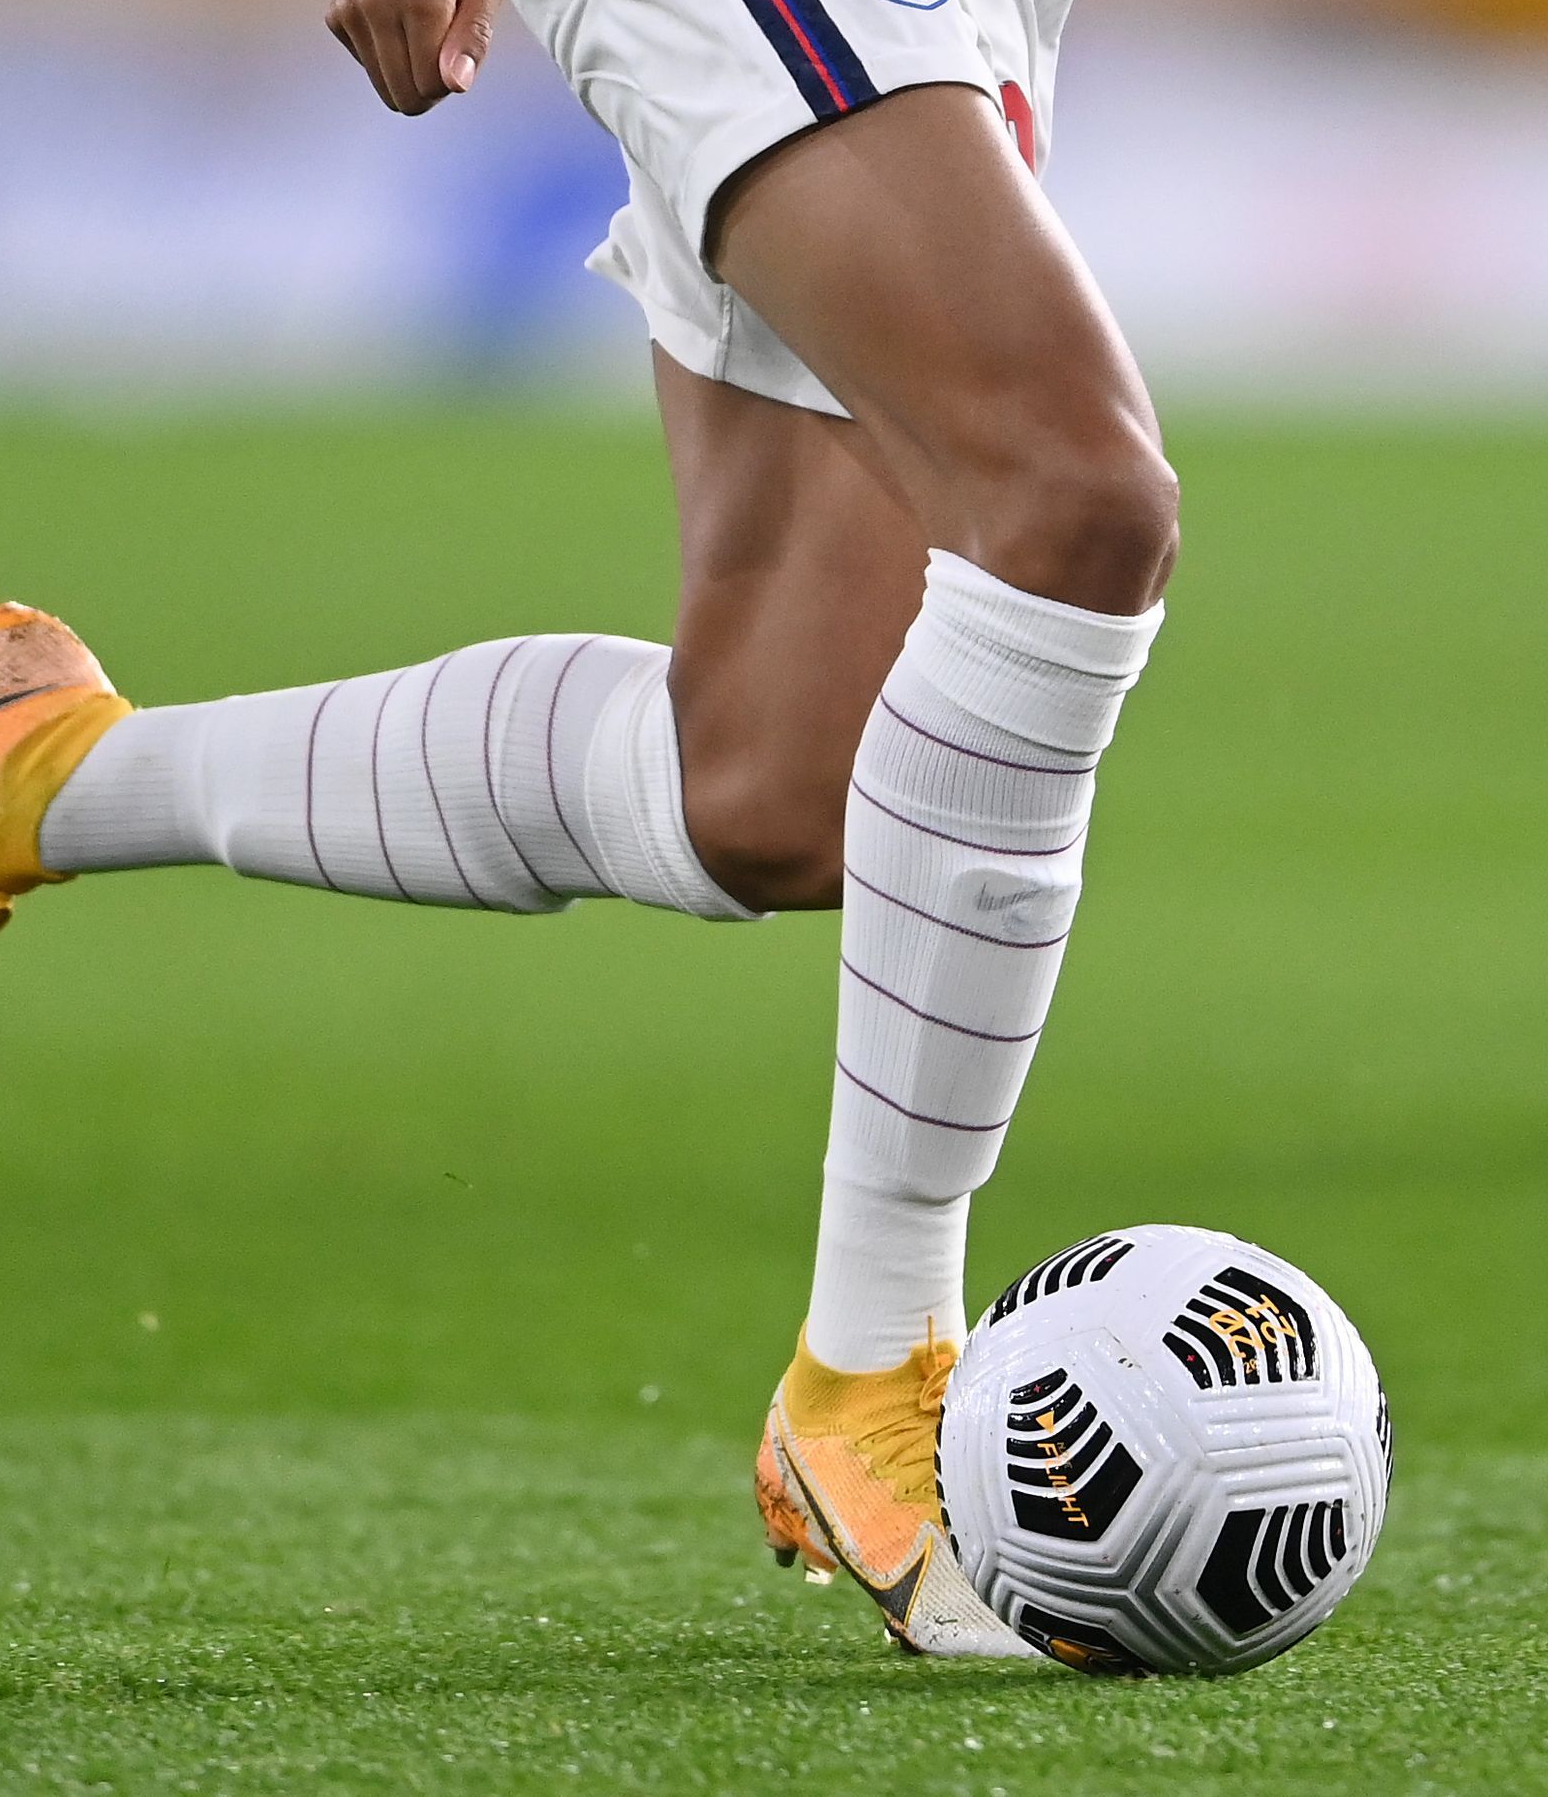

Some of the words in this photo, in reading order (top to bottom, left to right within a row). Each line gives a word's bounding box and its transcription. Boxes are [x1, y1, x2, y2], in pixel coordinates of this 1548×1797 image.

[1208, 1308, 1266, 1359] 20
[1244, 1293, 1297, 1344] 21
[1036, 1442, 1090, 1528] FLIGHT
